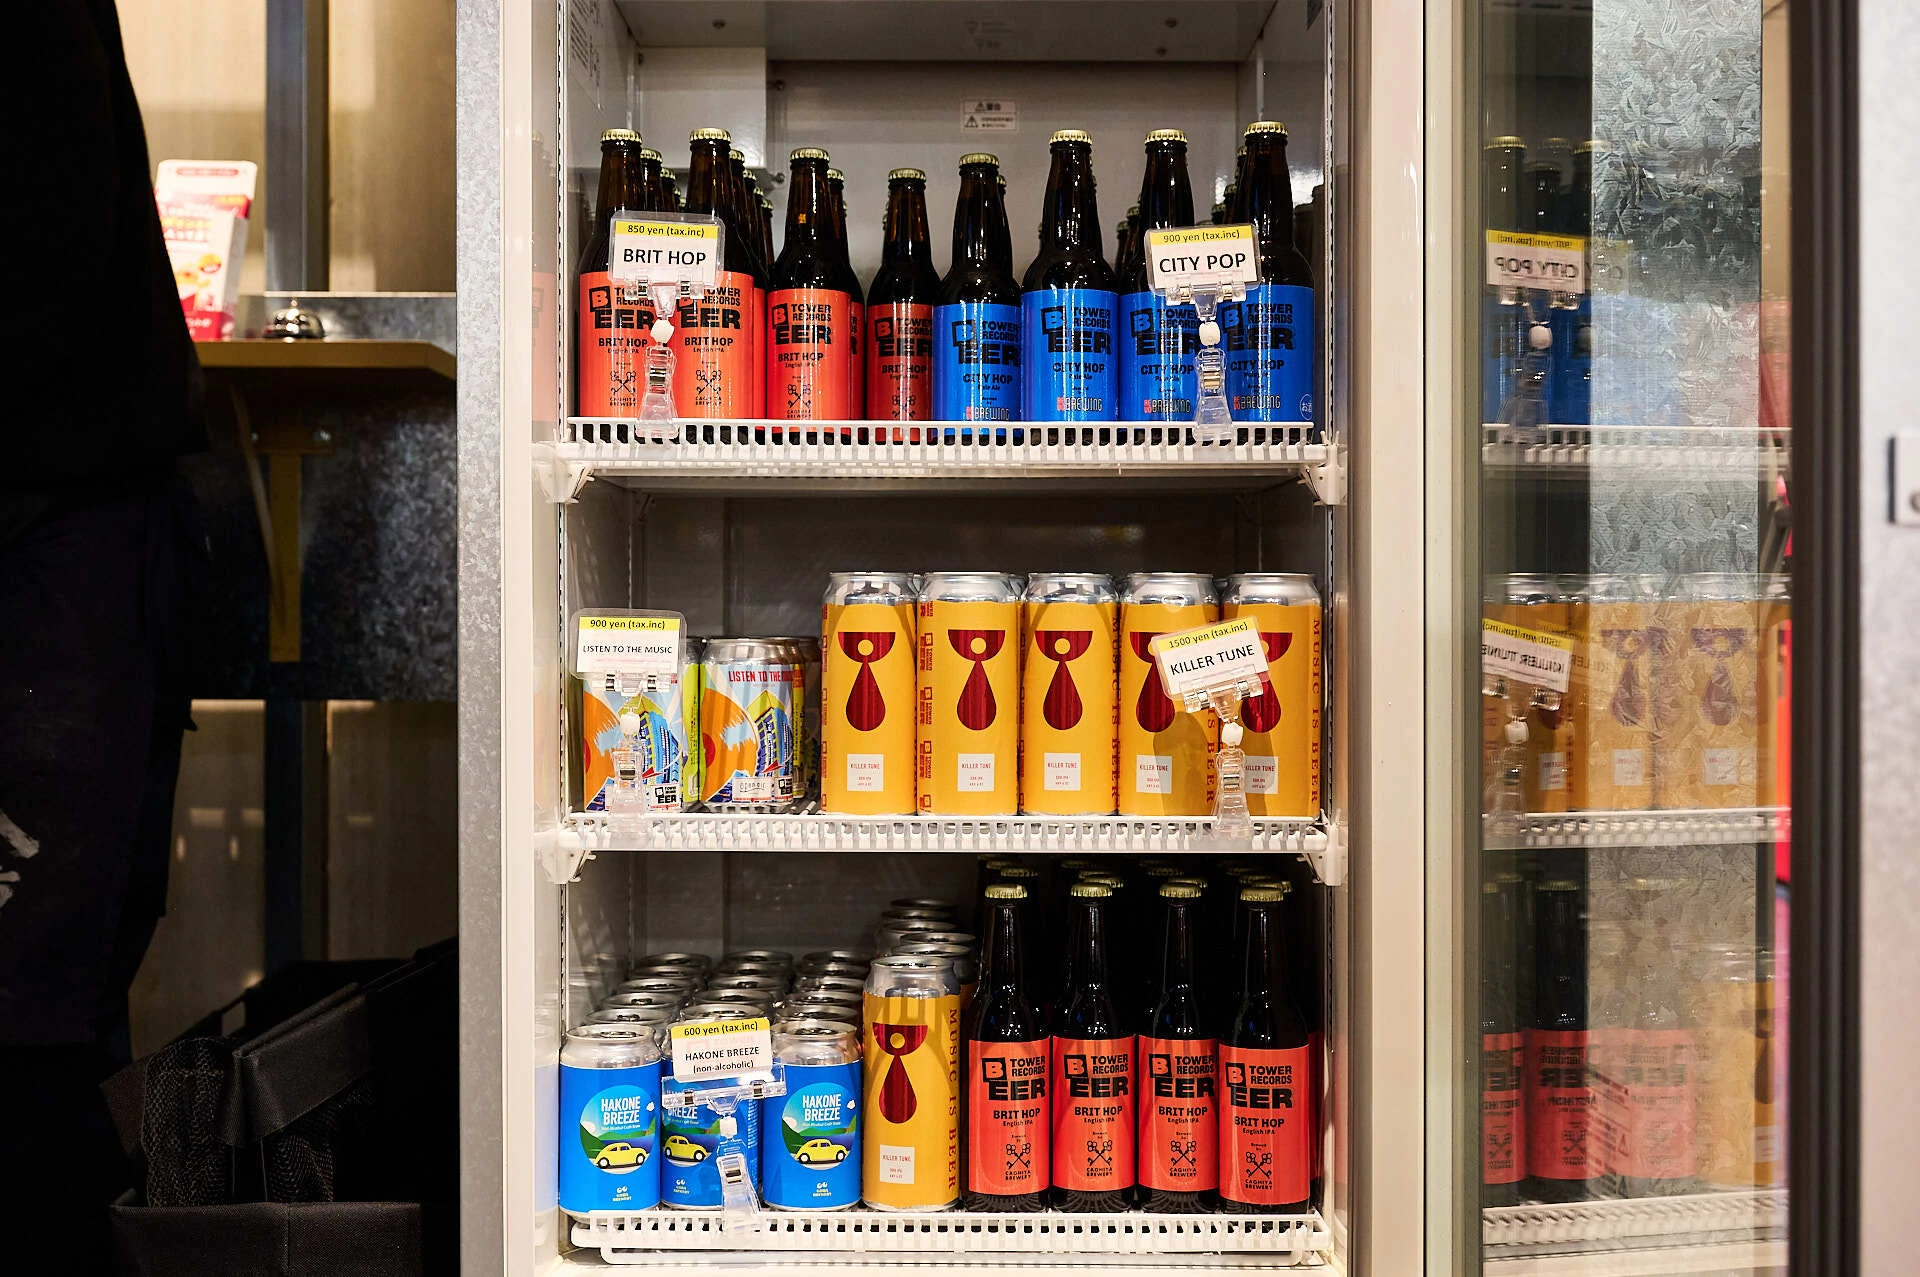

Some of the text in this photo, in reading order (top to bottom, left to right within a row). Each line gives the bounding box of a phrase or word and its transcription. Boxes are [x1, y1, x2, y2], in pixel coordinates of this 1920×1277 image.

[627, 225, 705, 238] 850 yen (tax.inc)
[1163, 230, 1240, 244] 900 yen (tax.inc)
[623, 248, 706, 266] BRIT HOP
[1159, 252, 1246, 273] CITY POP
[702, 296, 741, 307] RECORDS
[791, 304, 832, 314] TOWER
[1073, 306, 1111, 318] TOWER
[1247, 303, 1293, 314] TOWER
[792, 313, 832, 322] RECORDS
[982, 321, 1020, 332] TOWER
[598, 338, 648, 348] BRIT HOP
[684, 337, 734, 348] BRIT HOP
[778, 352, 824, 362] BRIT HOP
[881, 364, 927, 374] BRIT HOP
[1052, 362, 1105, 373] CITY HOP
[1140, 363, 1195, 375] CITY HOP
[1230, 360, 1285, 372] CITY HOP
[962, 373, 1013, 385] CITY HOP
[1065, 396, 1103, 411] BREWING
[1239, 394, 1281, 410] BREWING
[590, 619, 665, 630] 900 yen (tax.inc)
[1169, 621, 1249, 649] 1500 yen (tax.inc)
[583, 645, 611, 653] LISTEN
[644, 646, 673, 654] MUSIC
[1170, 644, 1255, 676] KILLER TUNE
[728, 670, 758, 682] LISTEN
[759, 671, 768, 682] TO
[769, 670, 780, 681] THE
[1311, 620, 1321, 802] MUSIC IS BEER
[1206, 742, 1216, 802] BEER
[684, 1021, 759, 1037] 600 yen (tax.inc)
[685, 1046, 760, 1061] HAKONE BREEZE
[1091, 1054, 1128, 1065] TOWER
[1010, 1055, 1045, 1068] TOWER
[1175, 1055, 1215, 1065] TOWER
[693, 1060, 754, 1074] (non-alcoholic)
[1012, 1066, 1045, 1077] RECORDS
[1092, 1063, 1128, 1075] RECORDS
[1176, 1064, 1214, 1075] RECORDS
[1249, 1065, 1292, 1075] TOWER
[1250, 1075, 1292, 1085] RECORDS
[601, 1095, 641, 1112] HAKONE
[802, 1094, 841, 1109] HAKONE
[948, 1008, 958, 1190] MUSIC IS BEER
[804, 1107, 841, 1122] BREEZE
[993, 1108, 1041, 1120] BRIT HOP
[1074, 1105, 1123, 1116] BRIT HOP
[1158, 1106, 1208, 1116] BRIT HOP
[603, 1110, 640, 1125] BREEZE
[1234, 1116, 1285, 1128] BRIT HOP
[1003, 1120, 1022, 1128] English
